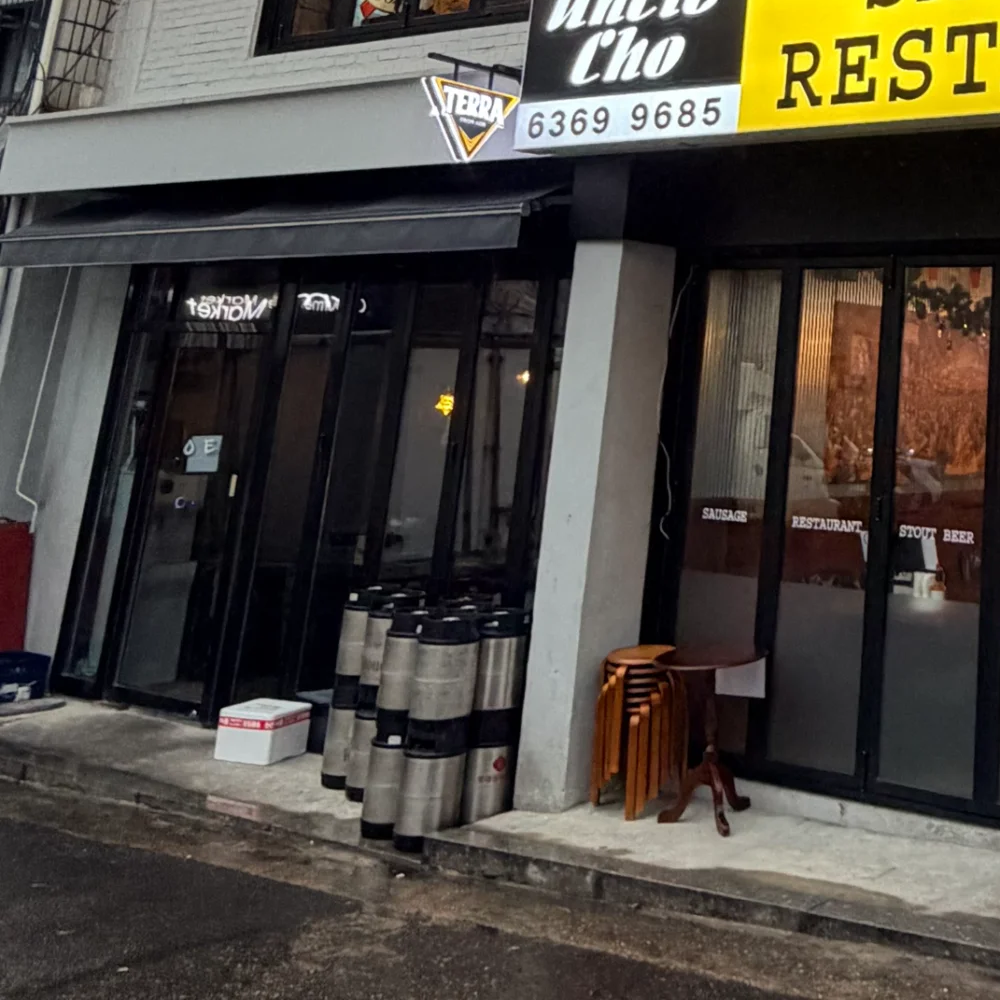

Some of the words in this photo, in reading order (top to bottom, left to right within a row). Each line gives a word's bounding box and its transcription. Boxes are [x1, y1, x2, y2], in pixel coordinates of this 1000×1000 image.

[569, 25, 687, 87] Cho
[443, 85, 504, 128] TERRA
[527, 106, 610, 139] 6369
[630, 98, 722, 131] 9685
[702, 507, 748, 523] SAUSAGE
[791, 515, 863, 534] RESTAURANT
[899, 524, 937, 540] STOUT
[943, 528, 975, 545] BEER
